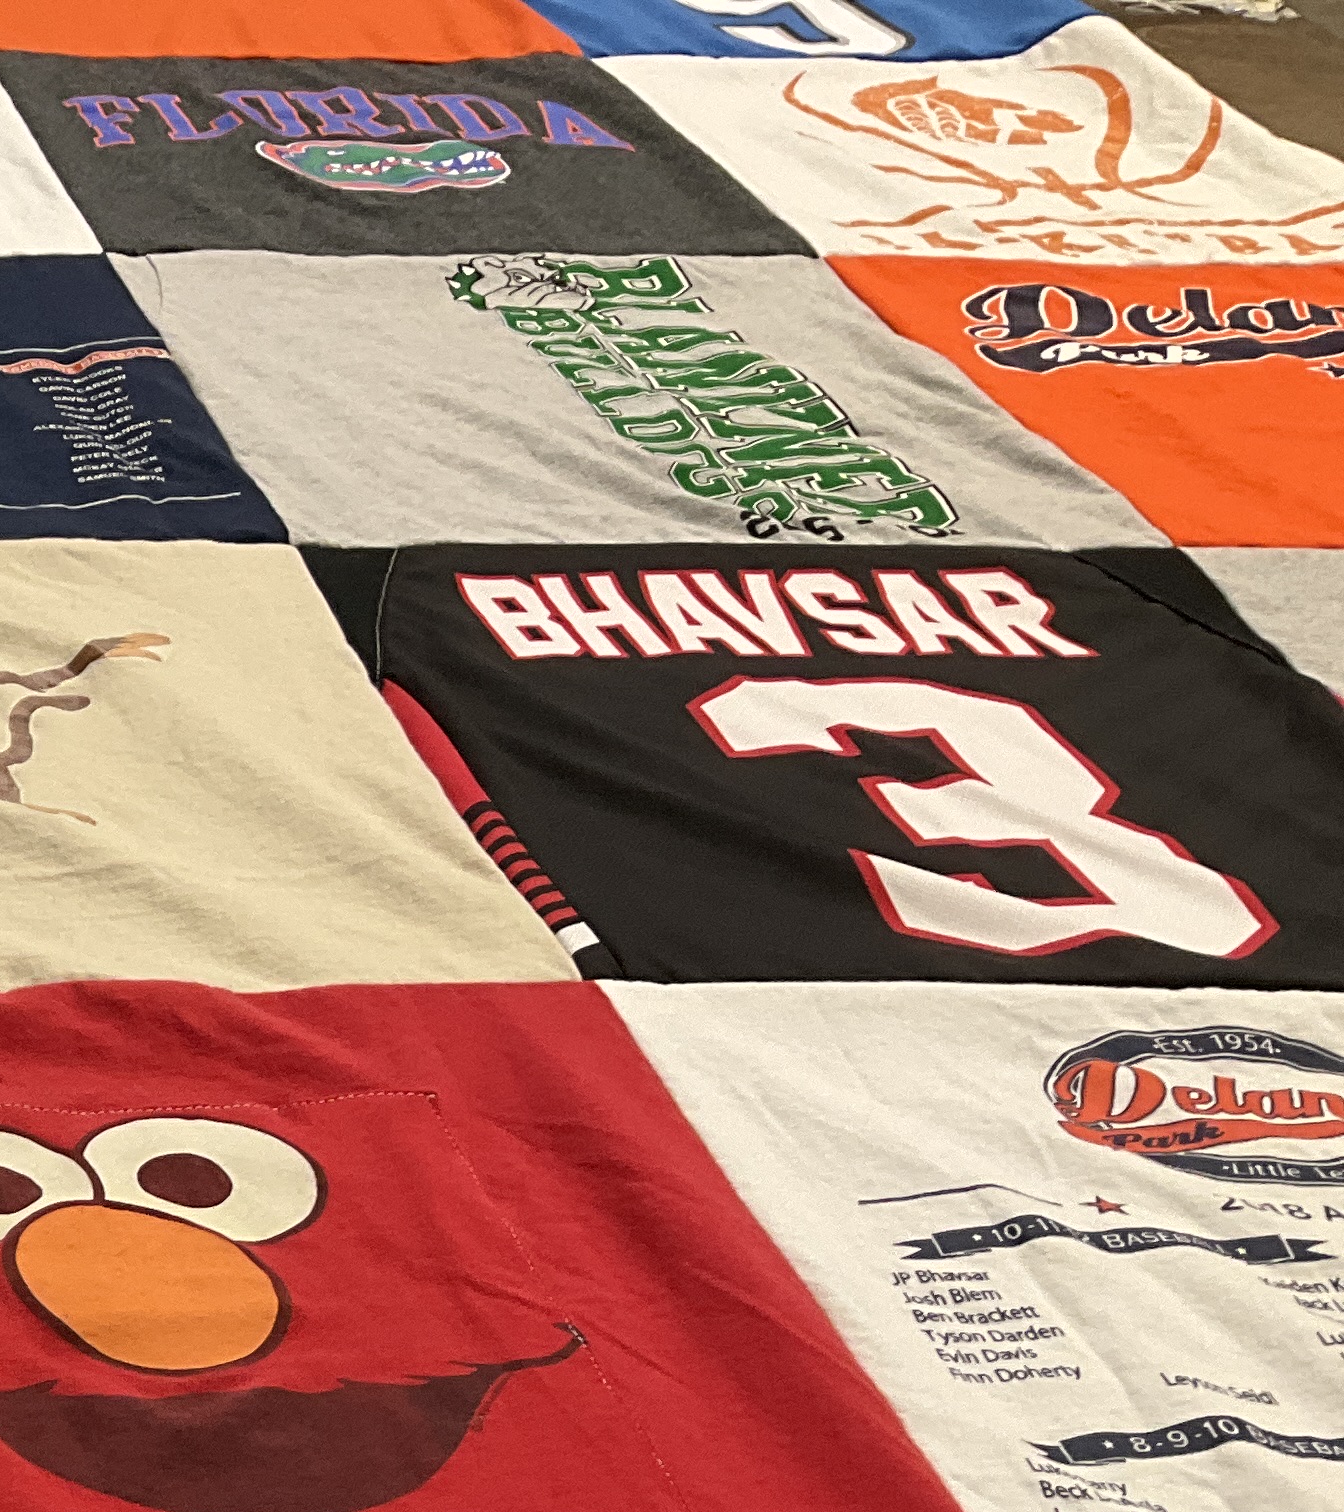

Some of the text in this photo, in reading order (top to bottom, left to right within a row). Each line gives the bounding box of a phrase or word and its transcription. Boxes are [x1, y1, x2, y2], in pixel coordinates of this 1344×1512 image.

[63, 86, 636, 153] FLORIDA
[454, 566, 1102, 660] BHAVSAR
[685, 675, 1282, 960] 3
[1209, 1033, 1275, 1054] 1954
[1102, 1120, 1226, 1148] Park
[1232, 1162, 1301, 1178] Little
[892, 1268, 990, 1287] JP Bhavsar
[903, 1286, 1003, 1306] Josh Blem
[913, 1304, 1041, 1325] Ben Brackett
[924, 1323, 1065, 1346] Tyson Darden
[936, 1344, 1039, 1363] Evin Davis
[949, 1362, 1083, 1385] Finn Doherty
[1130, 1418, 1240, 1454] 8-9-10
[1039, 1479, 1094, 1501] Beck
